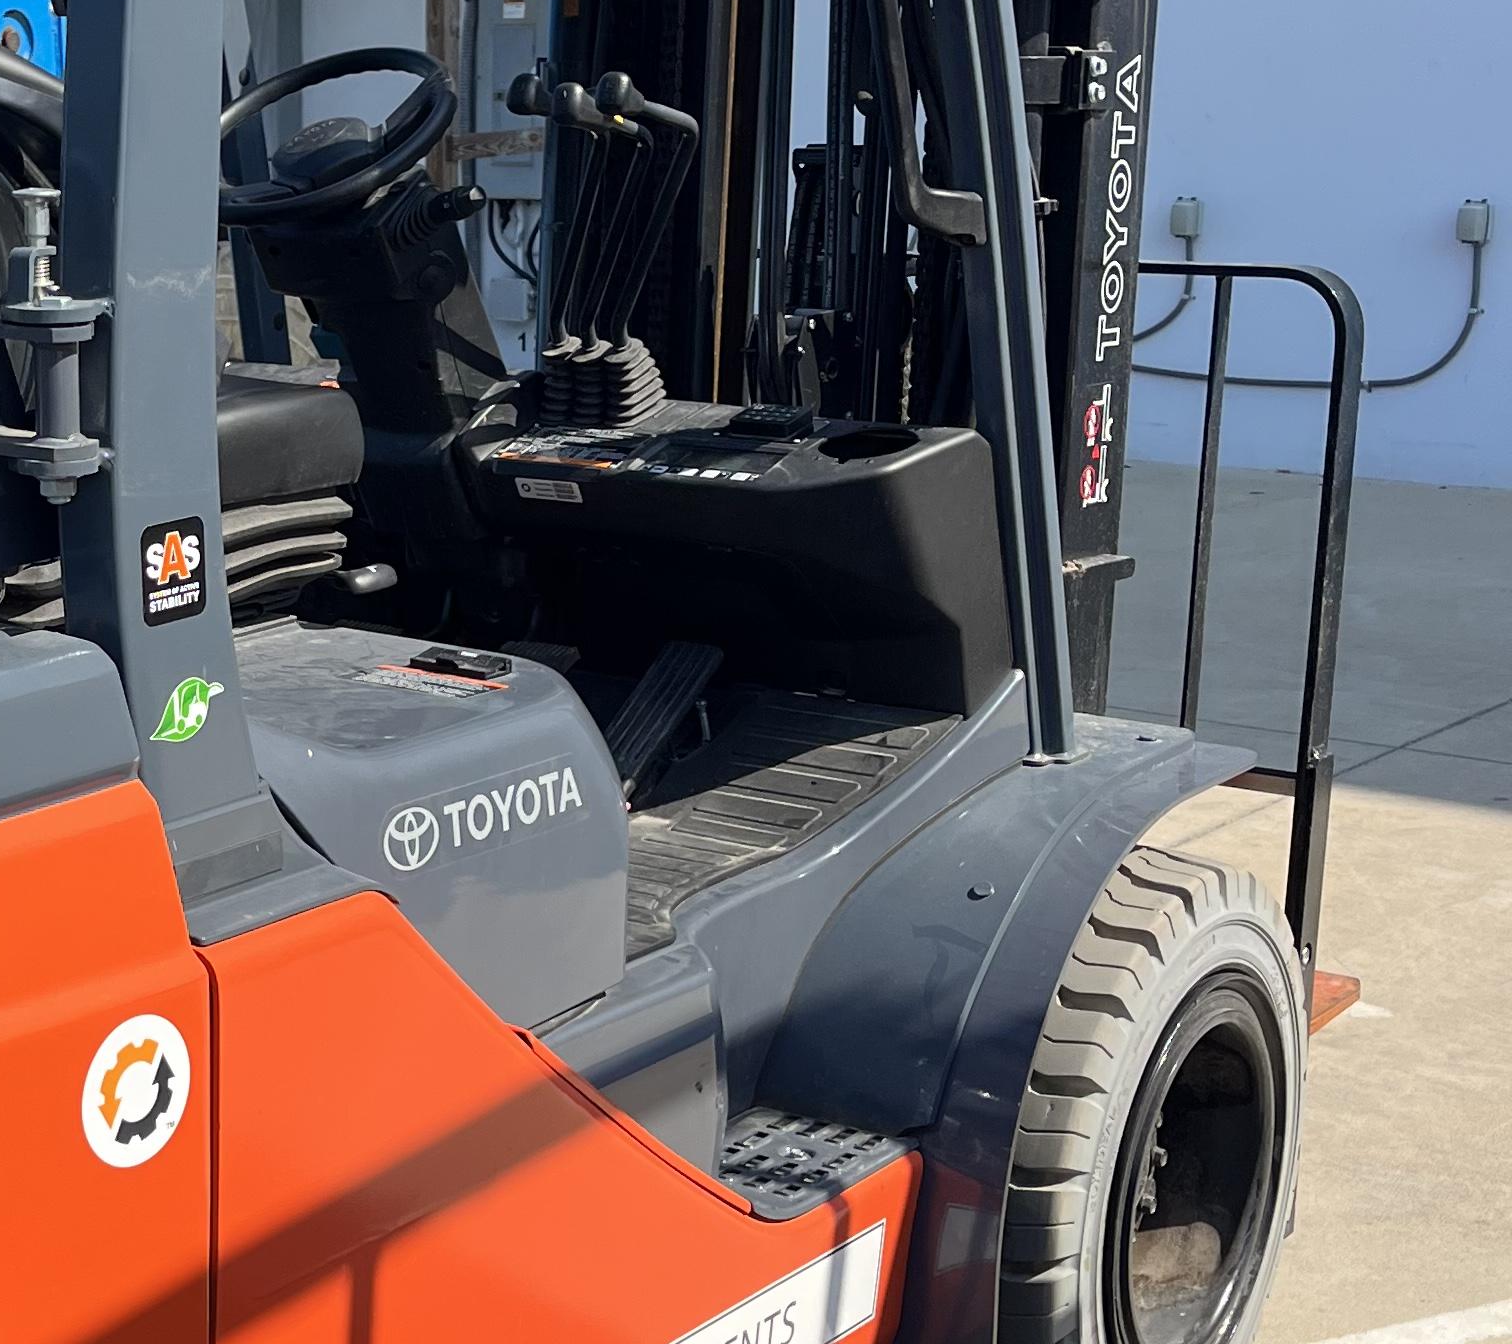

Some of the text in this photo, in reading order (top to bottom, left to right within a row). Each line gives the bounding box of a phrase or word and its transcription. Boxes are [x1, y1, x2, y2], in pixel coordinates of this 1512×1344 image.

[1095, 54, 1142, 362] TOYOTA
[146, 530, 201, 586] SAS
[149, 589, 201, 614] STABILITY
[443, 766, 583, 848] TOYOTA
